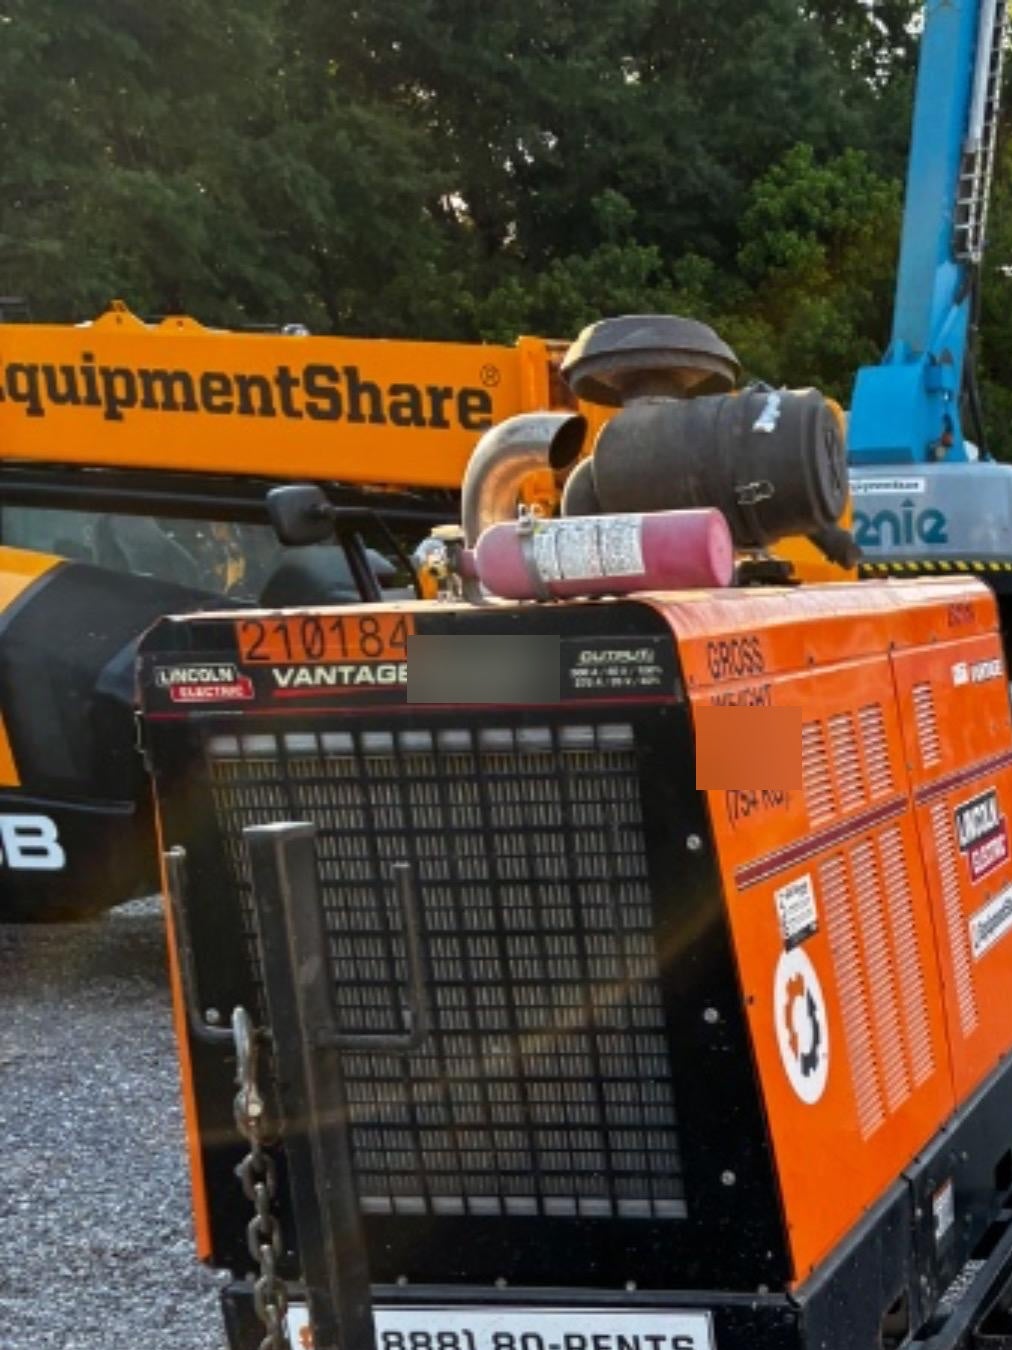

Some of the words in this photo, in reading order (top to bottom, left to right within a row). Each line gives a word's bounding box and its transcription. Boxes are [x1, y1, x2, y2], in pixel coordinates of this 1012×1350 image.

[0, 351, 493, 431] quipmentShare
[854, 499, 947, 546] enie
[242, 613, 408, 661] 210184
[707, 636, 764, 679] GROSS
[160, 667, 233, 686] LINCOLN
[179, 684, 244, 698] ELECTRIC
